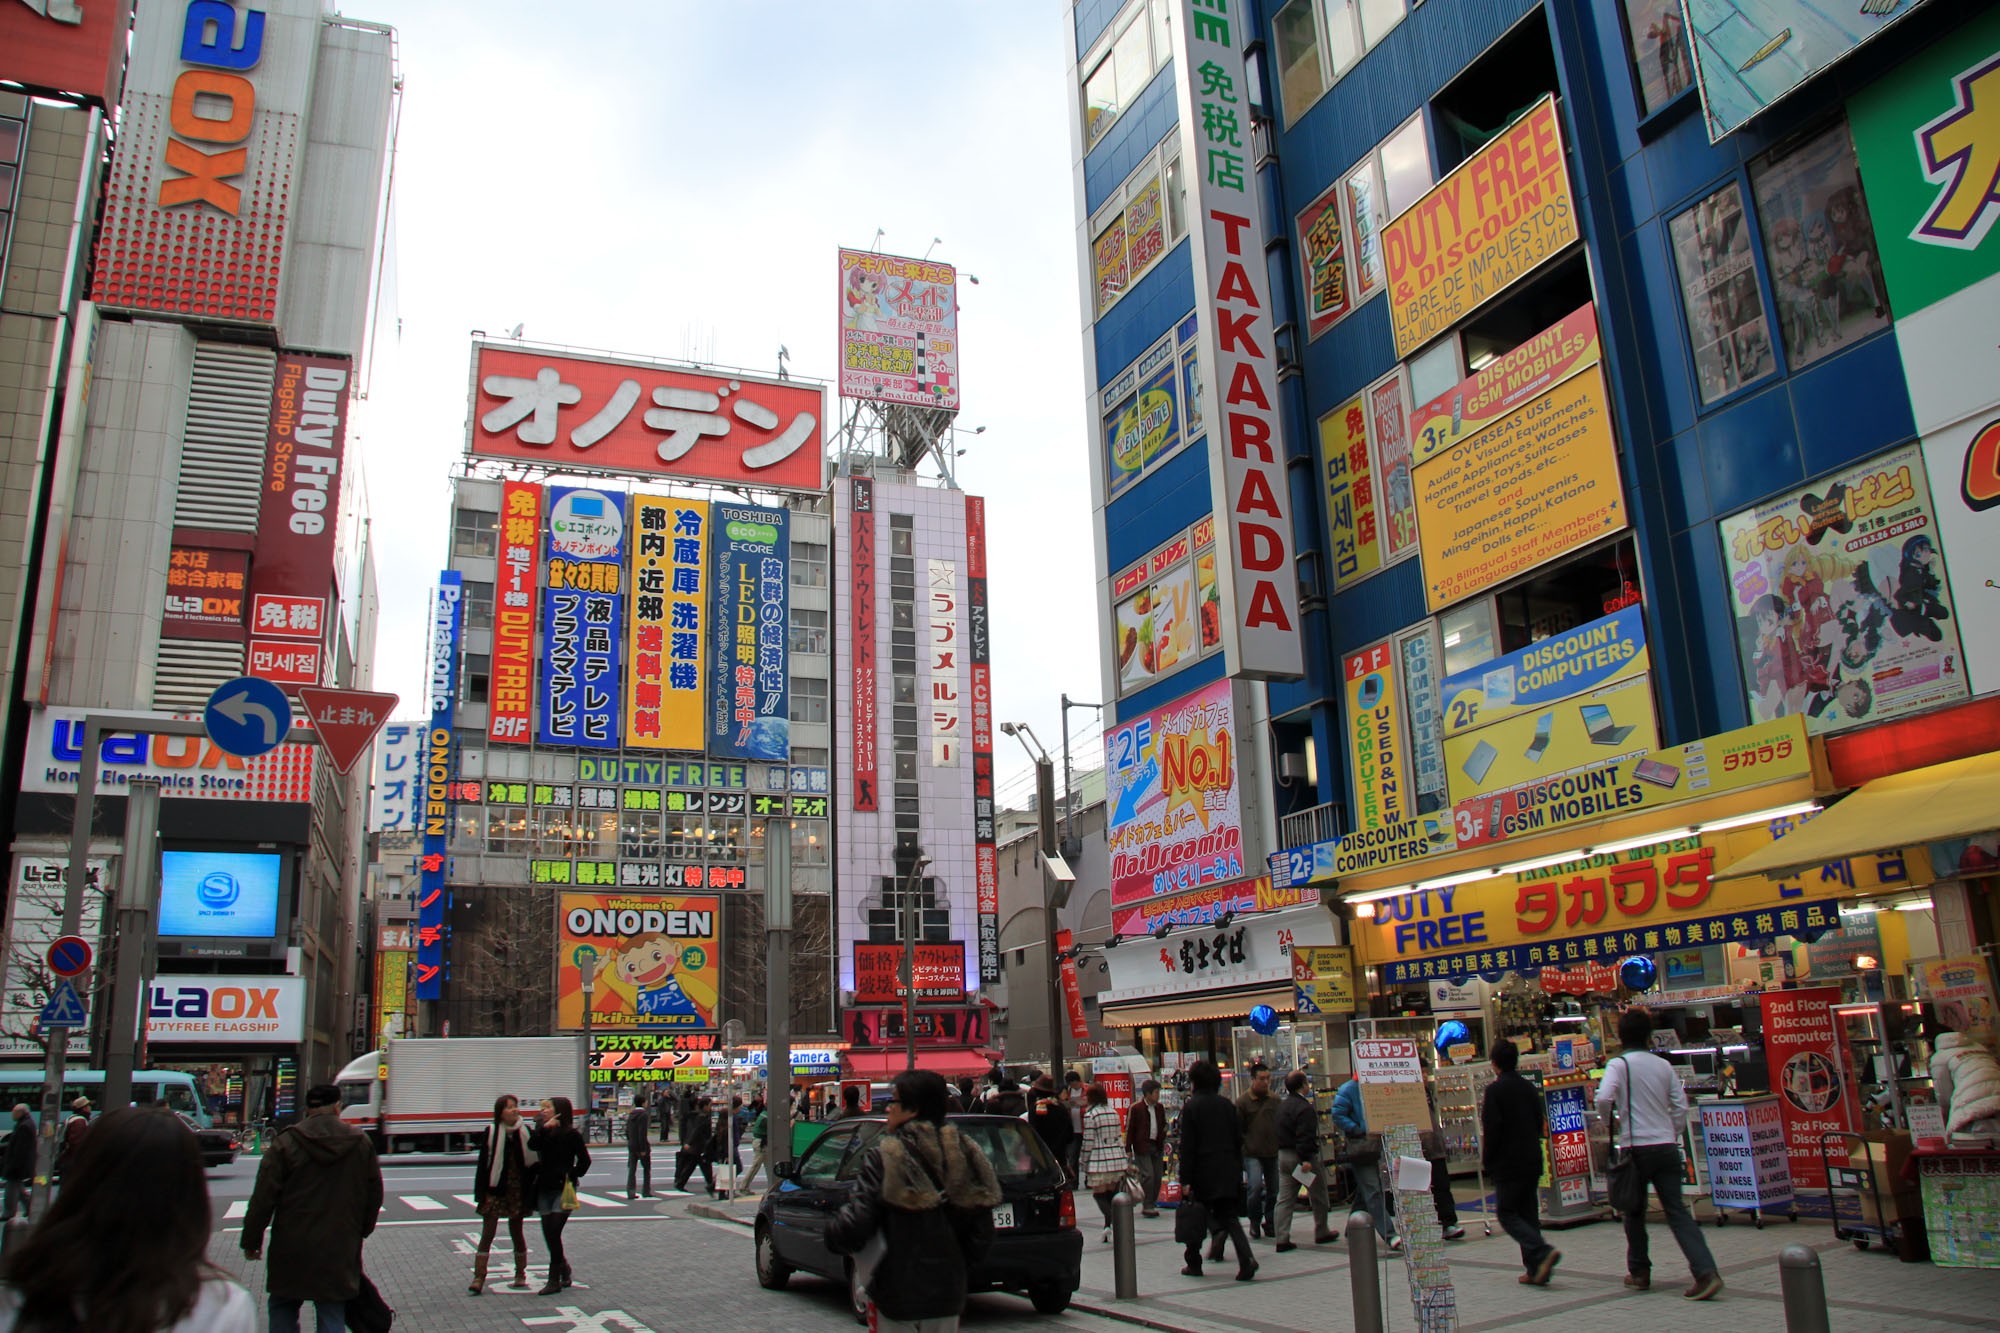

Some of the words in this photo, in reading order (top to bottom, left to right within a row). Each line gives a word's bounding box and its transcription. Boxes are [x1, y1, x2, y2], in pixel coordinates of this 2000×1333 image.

[1197, 59, 1245, 193] 免税店
[1385, 177, 1463, 285] DUTY
[1470, 106, 1561, 219] FREE
[1394, 281, 1415, 306] &
[1419, 167, 1561, 289] DISCOUNT
[1307, 208, 1344, 307] 麻雀
[1397, 290, 1438, 331] LIBRE
[1443, 269, 1464, 297] DE
[1467, 195, 1569, 281] IMPUESTOS
[1478, 323, 1566, 390] DISCOUNT
[1467, 384, 1503, 416] GSM
[1508, 332, 1586, 394] MOBILES
[272, 363, 302, 437] Flagship
[295, 366, 347, 450] Duty
[482, 366, 816, 469] オノデン
[1211, 209, 1293, 632] TAKARADA
[1451, 416, 1523, 462] OVERSEAS
[1526, 398, 1554, 425] USE
[1422, 426, 1447, 453] 3F
[1525, 425, 1588, 463] Suitcases
[271, 441, 293, 492] Store
[1428, 465, 1461, 490] Audio
[1476, 440, 1513, 461] Visual
[289, 455, 338, 536] Free
[1425, 481, 1459, 503] Home
[1453, 507, 1512, 541] Japanese
[1515, 473, 1579, 510] Souvenirs
[1455, 490, 1490, 514] Travel
[1498, 487, 1523, 507] and
[1545, 479, 1597, 508] Katana
[505, 490, 537, 546] 免税
[568, 523, 618, 538] エコポイント
[722, 508, 783, 525] TOSHIBA
[731, 525, 757, 537] eco
[1327, 451, 1359, 579] 면세점
[170, 551, 210, 569] 本店
[552, 539, 620, 557] オノデンポイント
[672, 509, 703, 596] 冷蔵庫
[730, 542, 774, 554] E-CORE
[1152, 539, 1188, 574] ドリンク
[1439, 577, 1454, 591] 20
[1456, 552, 1508, 582] Bilingual
[1511, 537, 1539, 558] Staff
[1542, 506, 1608, 543] Members
[1448, 585, 1461, 598] 10
[1464, 553, 1534, 591] Languages
[1536, 522, 1601, 557] available
[1482, 534, 1512, 554] Dolls
[168, 569, 244, 590] 総合家電
[549, 558, 620, 594] 益々お買得
[1117, 565, 1147, 594] フード
[259, 601, 318, 630] 免税
[433, 584, 460, 711] Panasonic
[499, 611, 531, 663] DUTY
[670, 601, 699, 691] 洗濯機
[1523, 620, 1620, 672] DISCOUNT
[253, 650, 317, 674] 면세점
[549, 595, 580, 737] プラズマテレビ
[583, 597, 613, 740] 液晶テレビ
[1517, 638, 1635, 694] COMPUTERS
[496, 665, 528, 712] FREE
[318, 704, 377, 727] 止まれ
[1160, 703, 1230, 737] メイドカフェ
[1409, 638, 1437, 776] COMPUTER
[1452, 700, 1479, 729] 2F
[492, 716, 529, 738] B1F
[1723, 742, 1761, 754] TAKARADA
[1764, 734, 1791, 744] MUSEN
[1116, 717, 1152, 772] 2F
[1161, 727, 1232, 795] No.1
[1723, 738, 1793, 772] タカラダ
[200, 774, 245, 790] Store
[426, 727, 450, 836] ONODEN
[1356, 713, 1378, 829] COMPUTERS
[686, 793, 744, 813] レンジ
[756, 796, 827, 817] オーディオ
[1203, 788, 1228, 811] 宣言
[1516, 766, 1619, 811] DISCOUNT
[1455, 810, 1483, 842] 3F
[1503, 808, 1544, 835] GSM
[1551, 783, 1644, 824] MOBILES
[1342, 819, 1418, 852] DISCOUNT
[1290, 852, 1313, 881] 2F
[1337, 838, 1429, 873] COMPUTERS
[684, 865, 745, 889] 特売中
[1153, 855, 1243, 894] めいどりーみん
[1515, 847, 1716, 934] タカラダ
[417, 853, 445, 984] オノデン
[608, 900, 658, 911] Welcome
[659, 901, 676, 911] to
[1373, 885, 1457, 925] DUTY
[1851, 914, 1868, 926] 3rd
[567, 908, 713, 938] ONODEN
[1277, 929, 1294, 944] 24
[1395, 911, 1488, 954] FREE
[1180, 926, 1247, 975] 富士そば
[1317, 952, 1346, 960] DISCOUNT
[1317, 991, 1347, 999] DISCOUNT
[1770, 1001, 1795, 1014] 2nd
[1797, 999, 1829, 1013] Floor
[214, 1022, 280, 1033] FLAGSHIP
[1773, 1015, 1829, 1030] Discount
[596, 1034, 674, 1051] プラズマテレビ
[1357, 1041, 1414, 1058] 秋葉マップ
[1703, 1112, 1714, 1127] B1
[1715, 1111, 1745, 1127] FLOOR
[1790, 1120, 1810, 1132] 3rd
[1812, 1119, 1842, 1132] Floor
[1707, 1146, 1751, 1157] COMPUTER
[1710, 1132, 1744, 1143] ENGLISH
[1718, 1161, 1743, 1172] ROBOT
[1560, 1180, 1584, 1192] 2F
[1714, 1189, 1757, 1201] SOUVENIER
